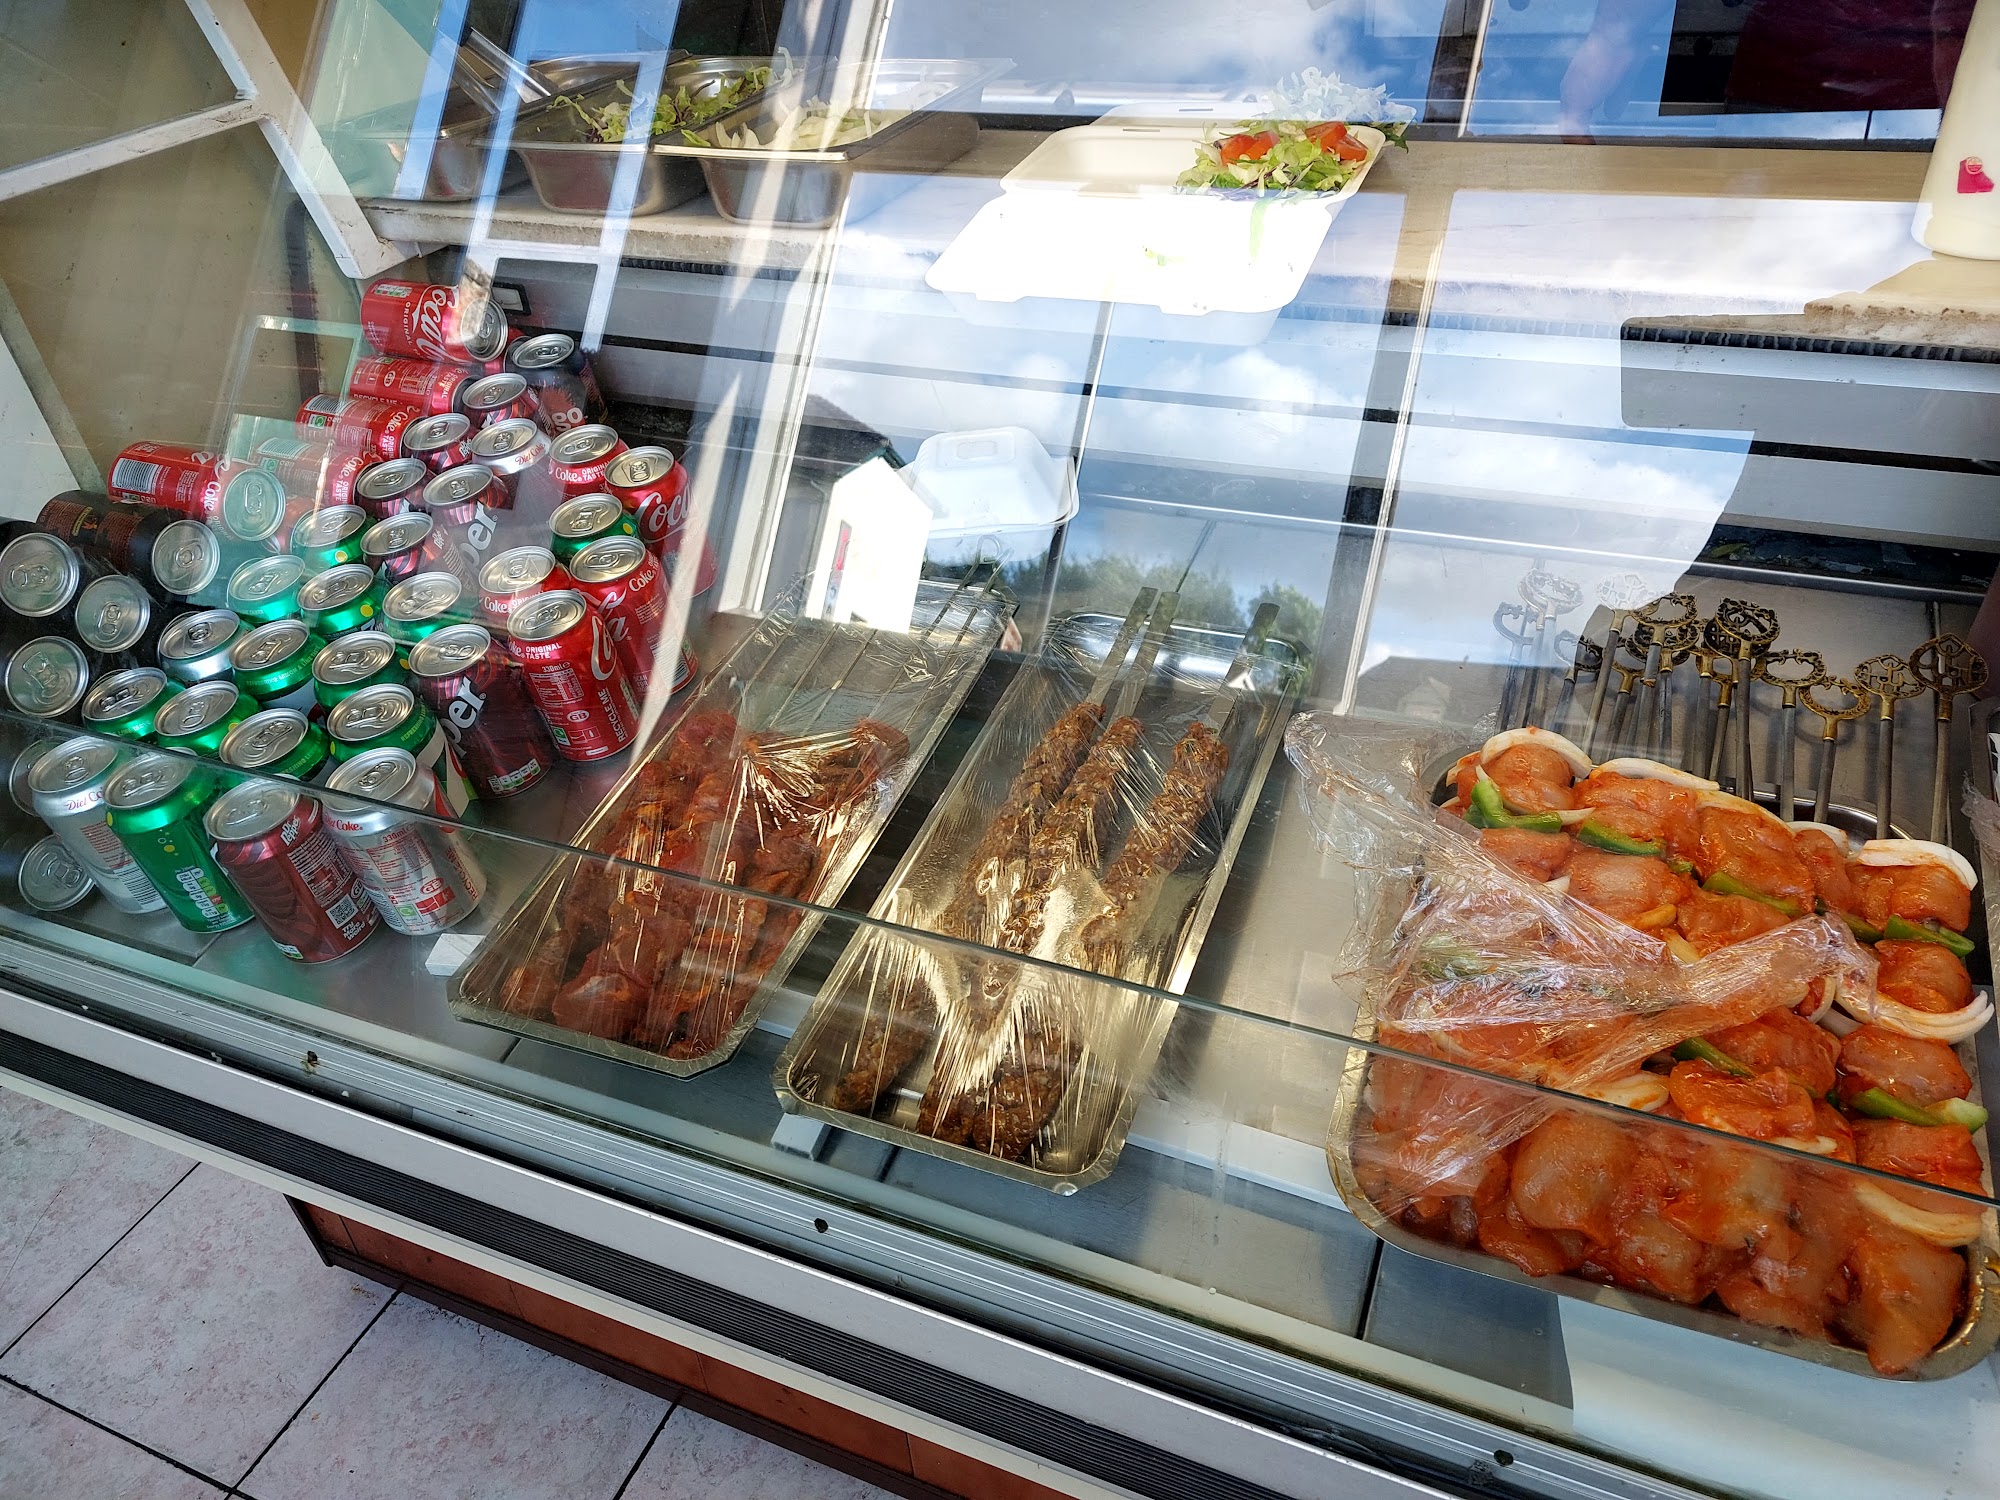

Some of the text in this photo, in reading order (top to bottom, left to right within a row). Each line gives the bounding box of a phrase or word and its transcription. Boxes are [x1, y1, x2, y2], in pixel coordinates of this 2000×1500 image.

[387, 410, 408, 432] Coke
[343, 456, 364, 477] Coke
[555, 467, 578, 482] Coke
[203, 481, 222, 511] Coke
[629, 569, 654, 592] Coke
[484, 596, 508, 614] Coke
[525, 642, 562, 653] ORIGINAL
[525, 651, 551, 660] TASTE
[597, 688, 627, 744] RECYCLE ME
[64, 799, 87, 811] Diet
[336, 819, 360, 832] Coke
